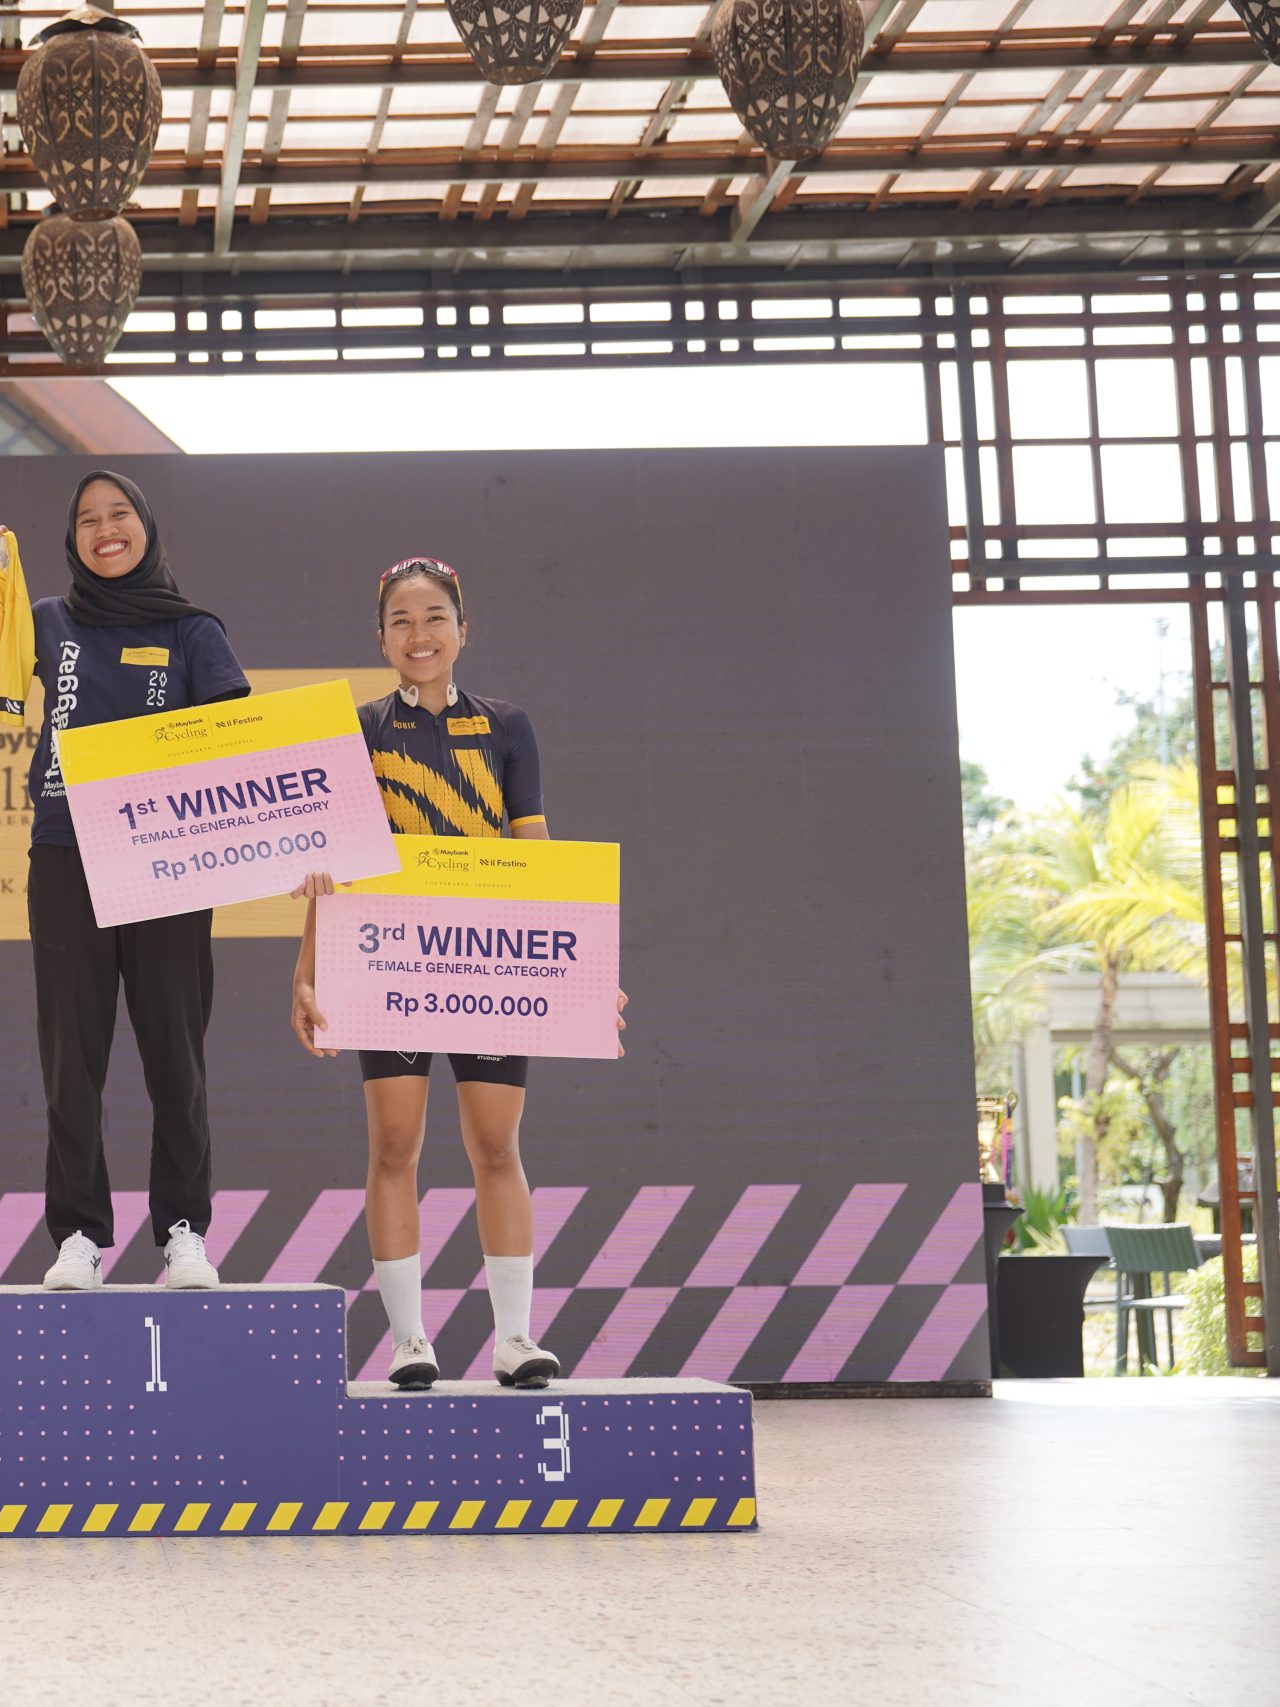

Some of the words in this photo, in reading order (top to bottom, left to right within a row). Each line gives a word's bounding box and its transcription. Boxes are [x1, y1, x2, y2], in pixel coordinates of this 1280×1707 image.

[149, 670, 167, 687] 20
[146, 688, 166, 706] 25
[233, 715, 263, 726] Festino
[164, 728, 208, 742] Cycling
[118, 798, 158, 830] 1st
[167, 768, 332, 821] WINNER
[131, 827, 187, 846] FEMALE
[189, 815, 255, 837] GENERAL
[257, 800, 330, 824] CATEGORY
[151, 859, 188, 880] Rp
[189, 830, 327, 872] 10.000.000
[440, 849, 468, 857] Maybank
[427, 858, 469, 872] Cycling
[358, 923, 405, 953] 3rd
[417, 925, 577, 961] WINNER
[368, 960, 422, 973] FEMALE
[425, 962, 490, 975] GENERAL
[494, 964, 567, 978] CATEGORY
[386, 991, 419, 1017] Rp
[424, 993, 548, 1017] 3.000.000
[144, 1317, 167, 1392] 1
[536, 1406, 571, 1481] 3
